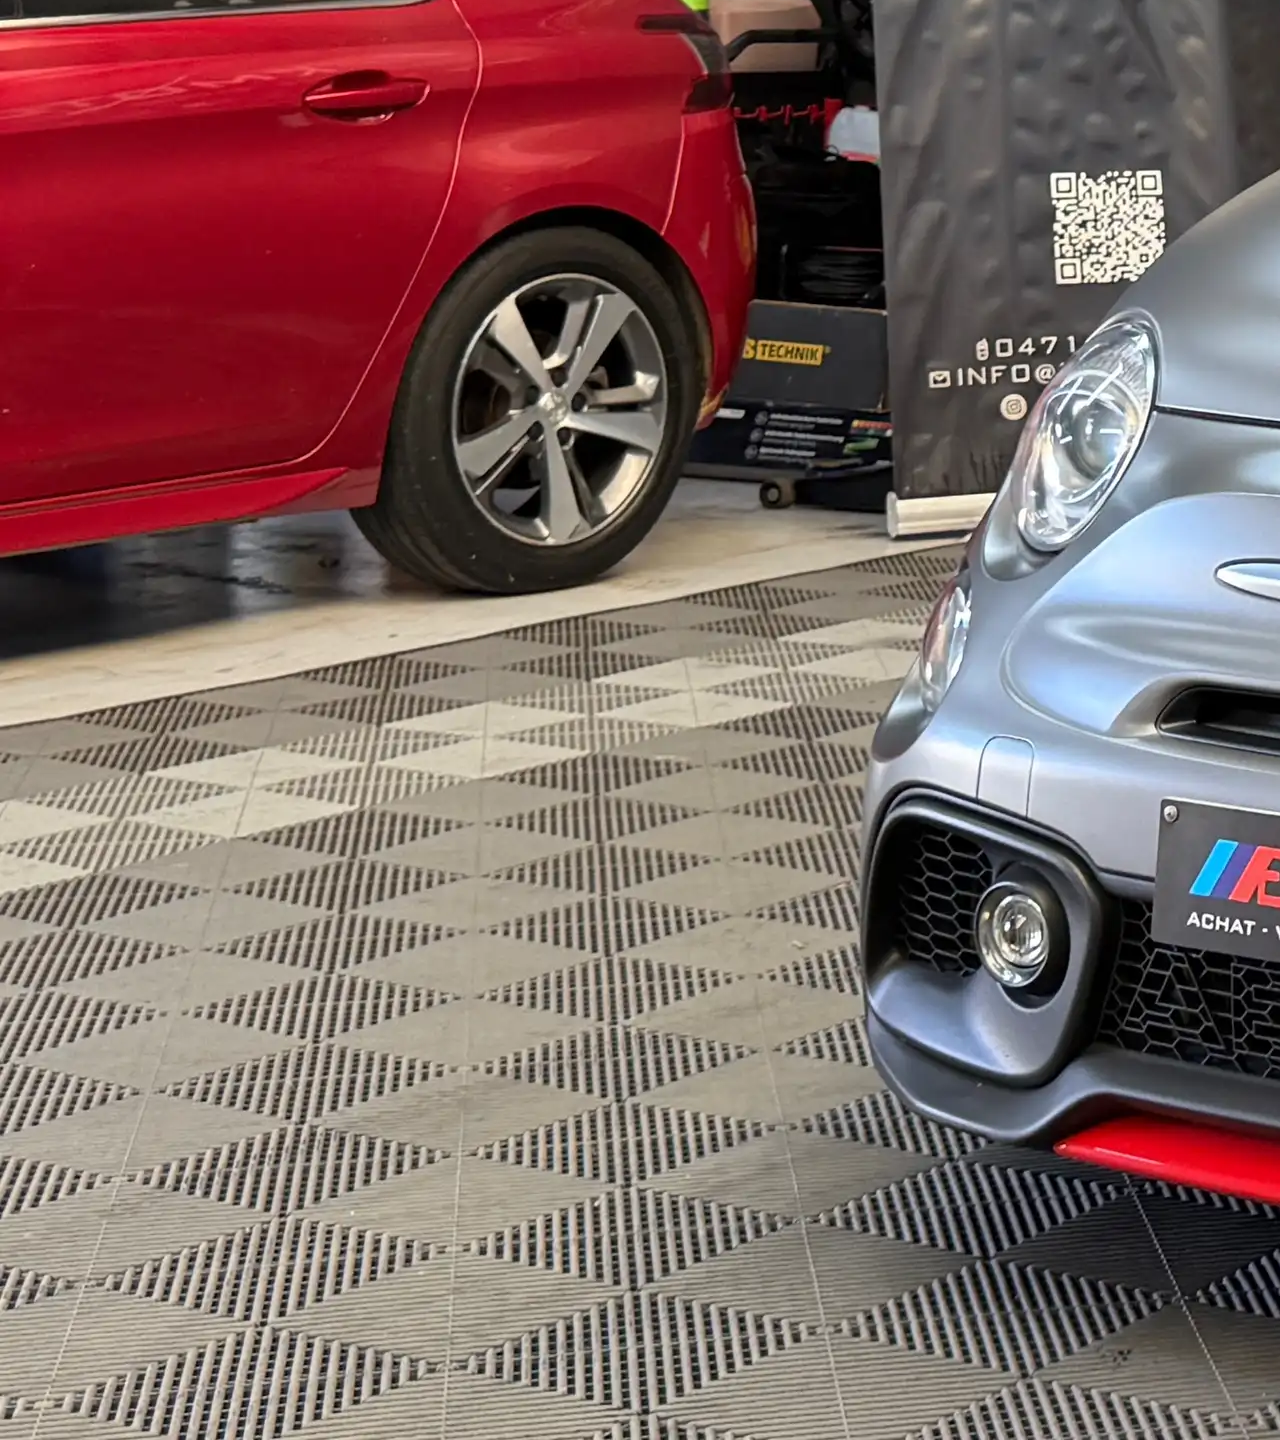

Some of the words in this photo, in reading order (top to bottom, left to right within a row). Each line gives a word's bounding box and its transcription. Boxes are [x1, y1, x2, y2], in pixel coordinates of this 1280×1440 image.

[995, 336, 1076, 358] 0471
[957, 362, 1064, 386] INFO@
[1186, 911, 1256, 937] ACHAT
